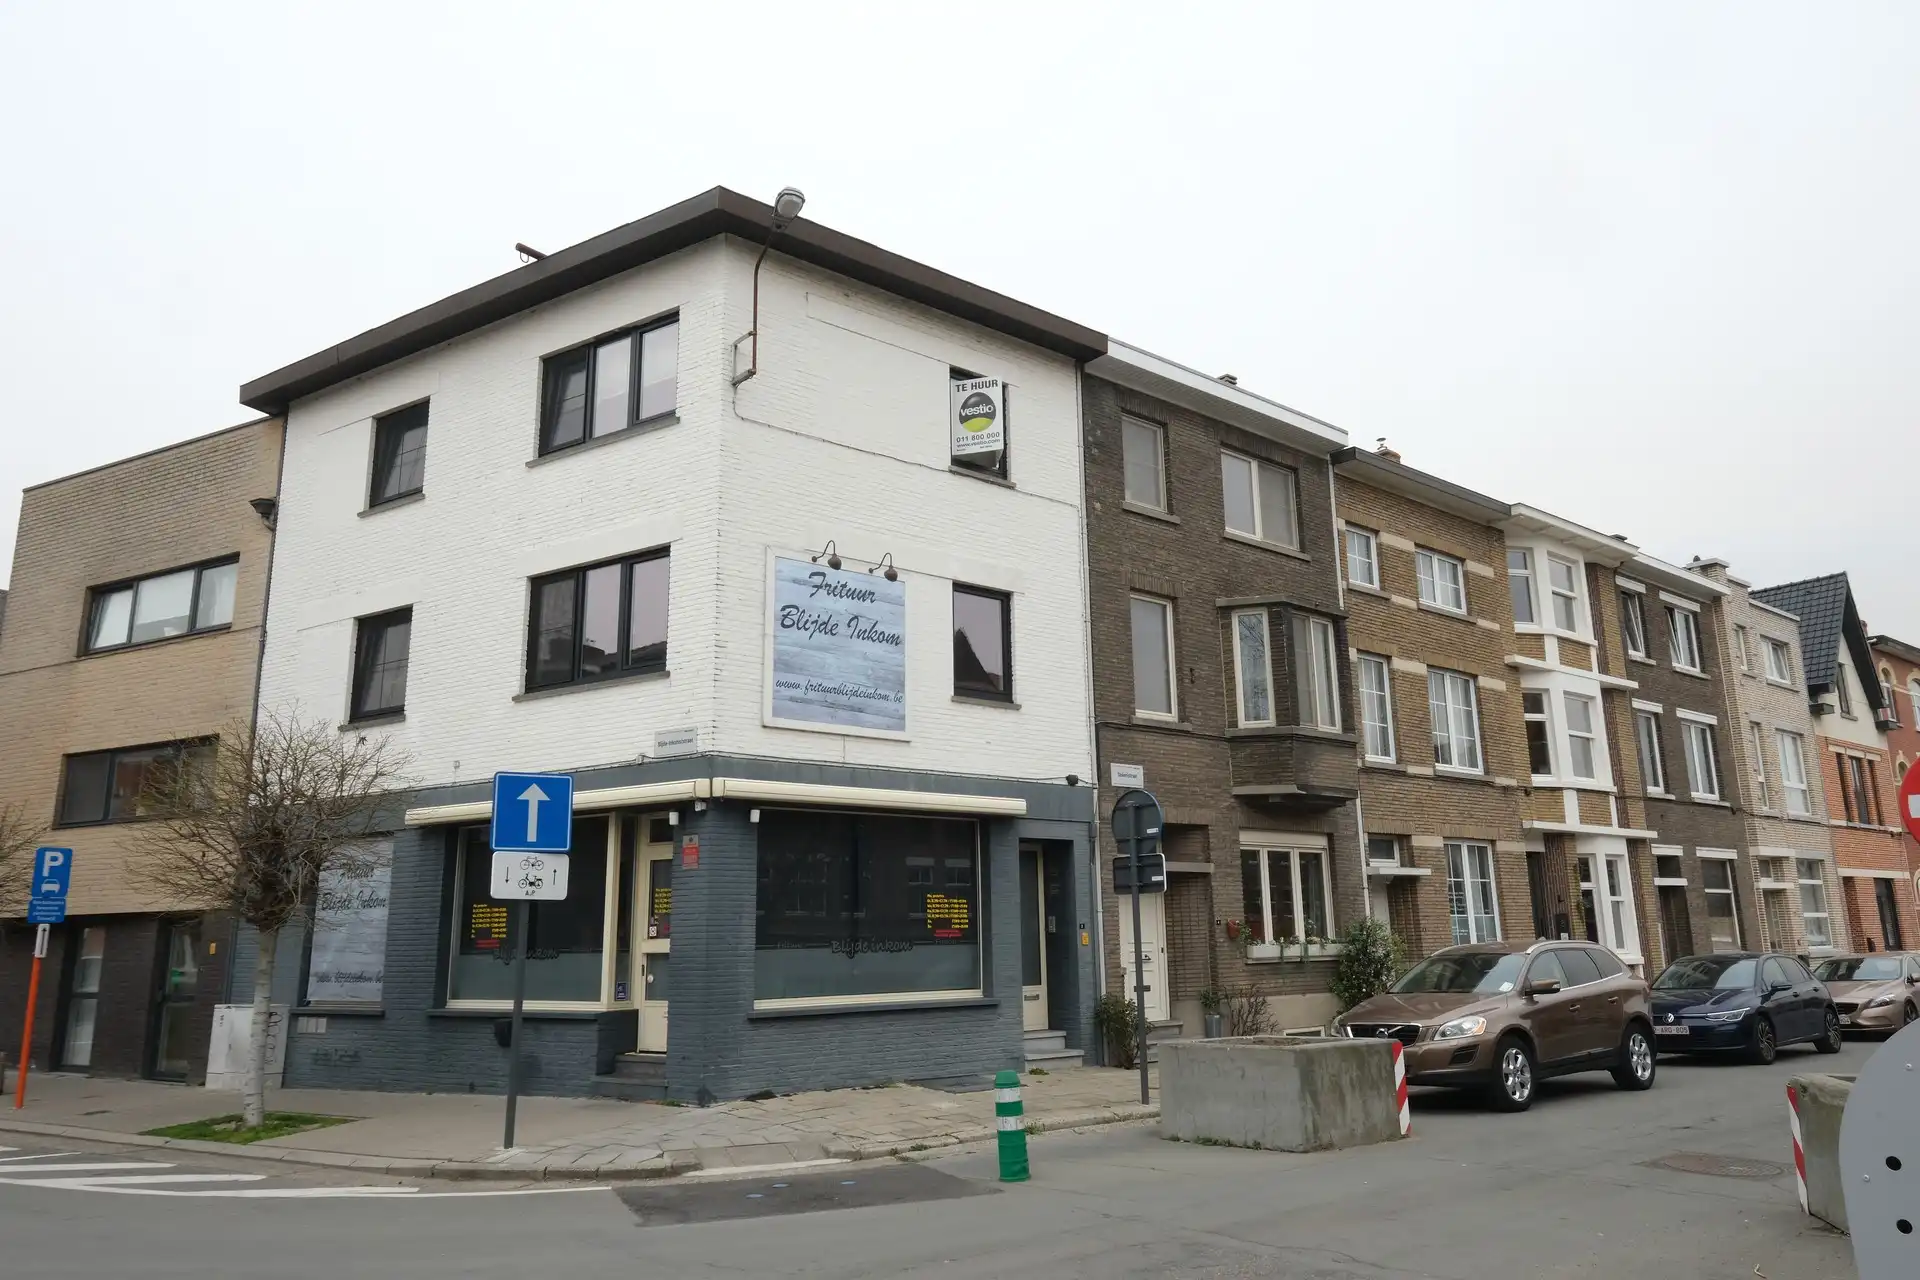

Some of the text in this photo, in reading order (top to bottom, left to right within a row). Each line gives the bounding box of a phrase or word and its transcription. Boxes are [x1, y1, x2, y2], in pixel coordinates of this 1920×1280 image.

[955, 380, 999, 393] TE HUUR
[960, 404, 994, 416] vestio
[808, 571, 877, 604] Frituur
[780, 604, 901, 647] Blijde Inkom
[775, 679, 903, 704] www.frituurblijdeinkom.be
[42, 851, 64, 877] P
[831, 939, 869, 959] Blijde
